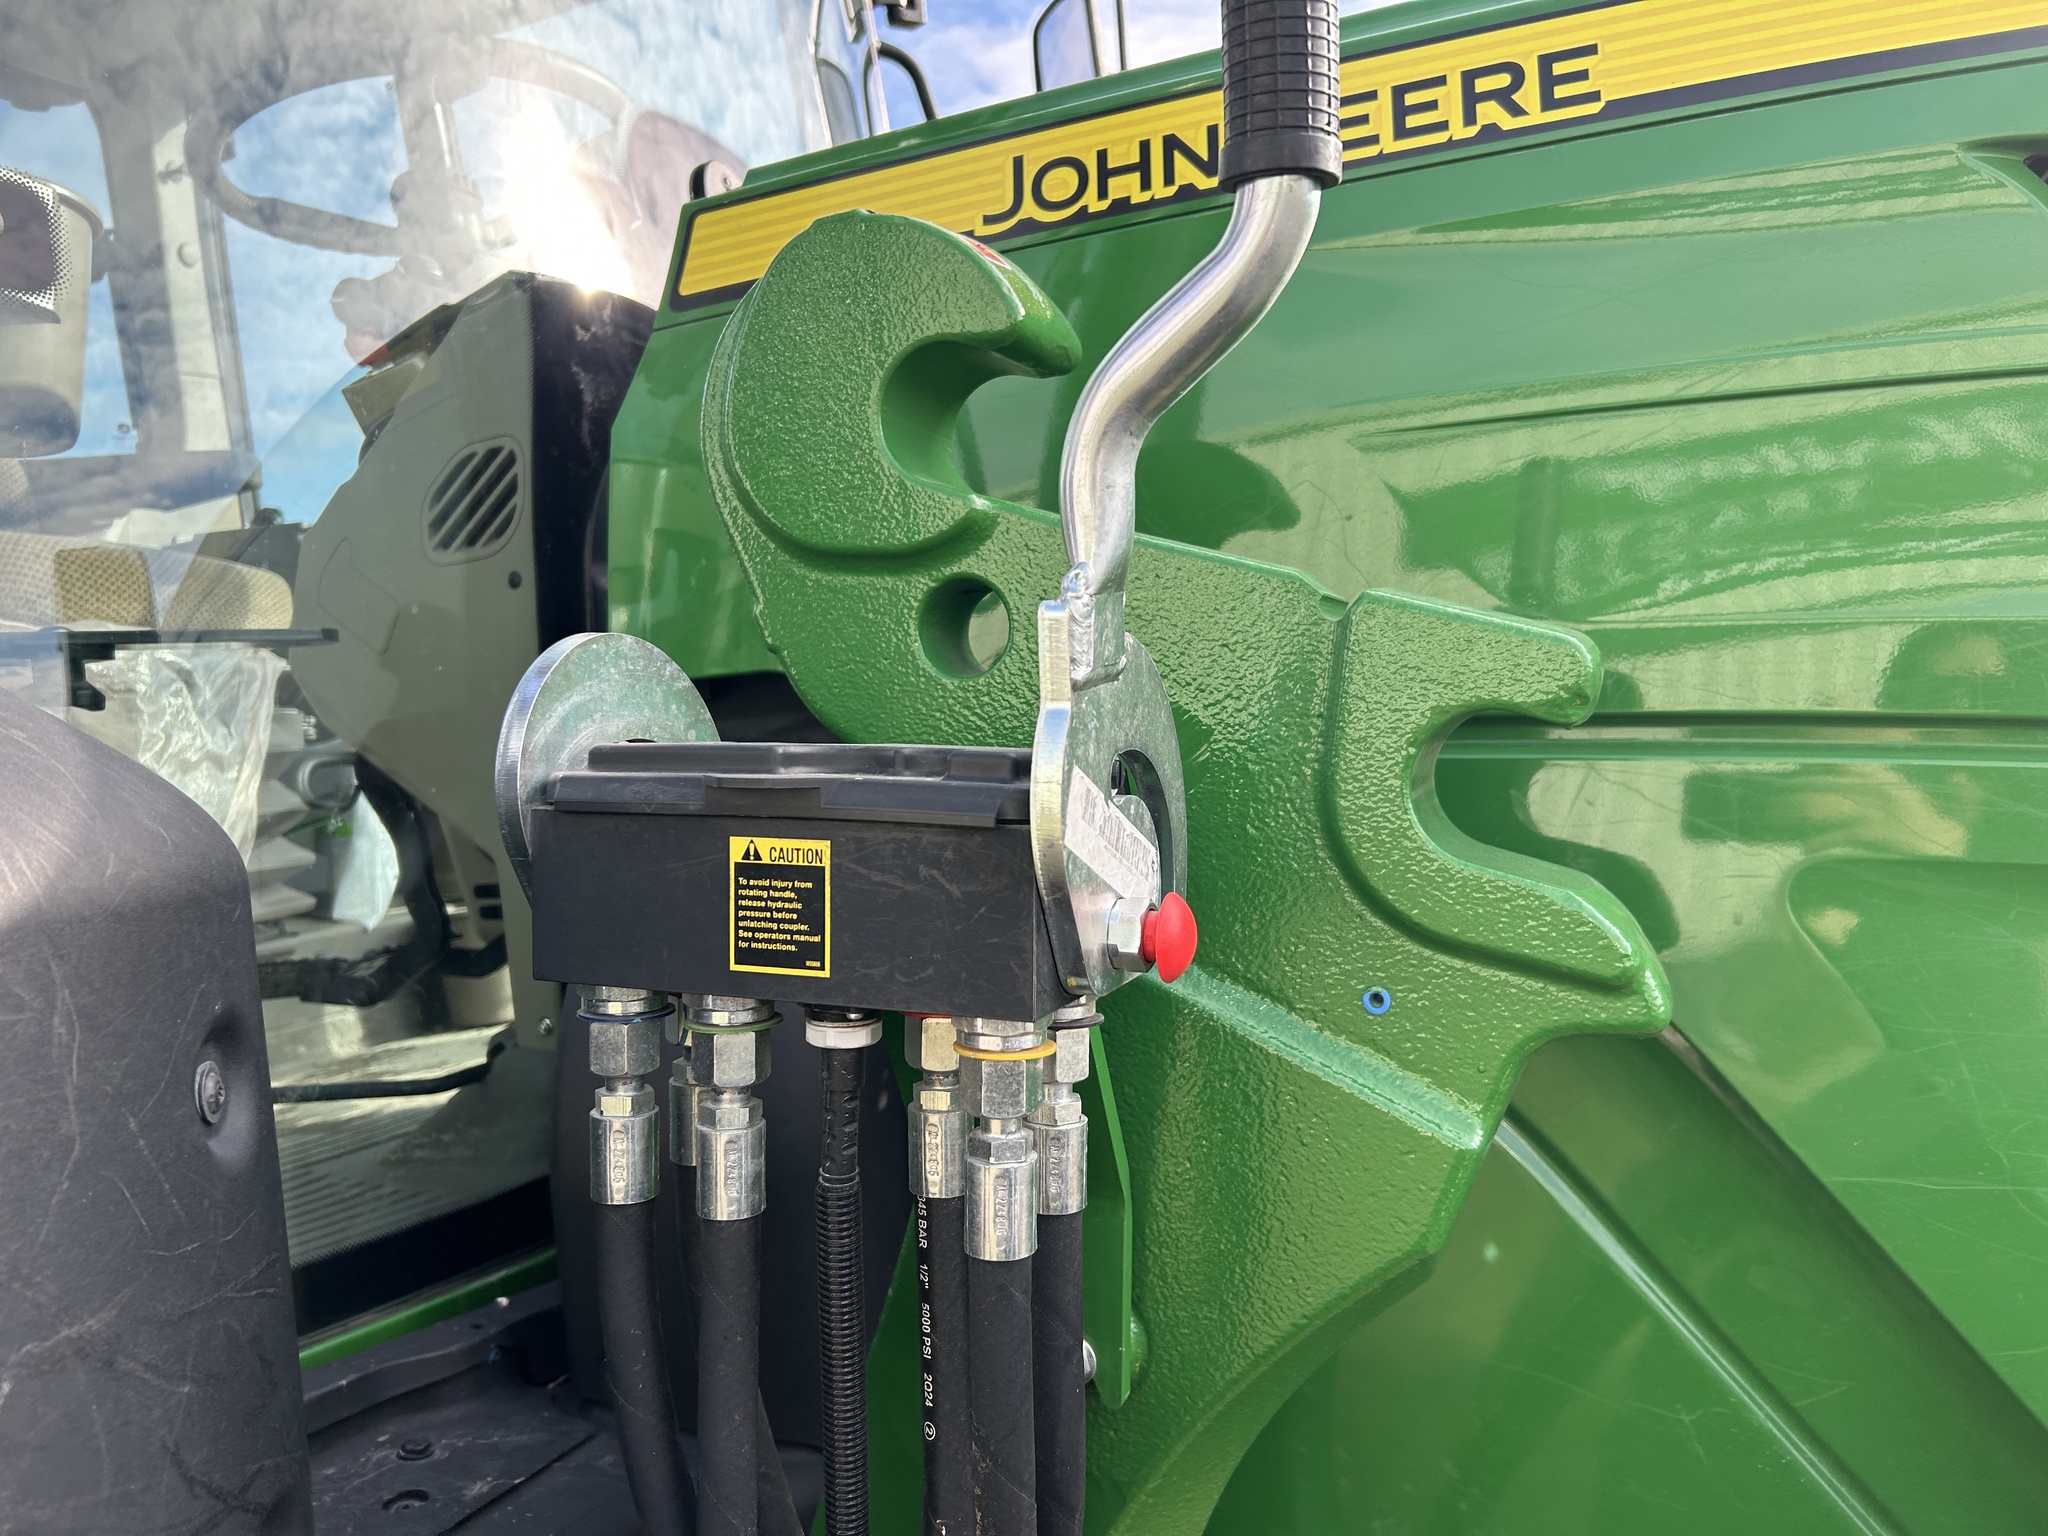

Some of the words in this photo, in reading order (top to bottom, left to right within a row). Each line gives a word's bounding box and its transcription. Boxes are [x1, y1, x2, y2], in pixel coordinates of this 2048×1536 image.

[982, 123, 1219, 226] JOHN
[1340, 42, 1602, 149] EERE
[769, 846, 823, 864] CAUTION
[738, 877, 748, 886] To
[749, 878, 770, 887] avoid
[771, 880, 793, 889] injury
[794, 880, 812, 889] from
[738, 889, 768, 898] rotating
[769, 890, 798, 900] handle,
[738, 899, 766, 907] release
[767, 900, 803, 910] hydraulic
[738, 910, 771, 918] pressure
[773, 911, 798, 919] before
[738, 920, 778, 930] unlatching
[779, 922, 810, 932] coupler.
[754, 932, 791, 940] operators
[792, 934, 821, 943] manual
[738, 940, 750, 948] for
[750, 941, 798, 952] instructions.
[918, 1219, 928, 1249] BAR
[919, 1263, 930, 1289] 1/2"
[921, 1302, 931, 1333] 5000
[922, 1336, 932, 1359] PSI
[923, 1372, 934, 1407] 2Q24
